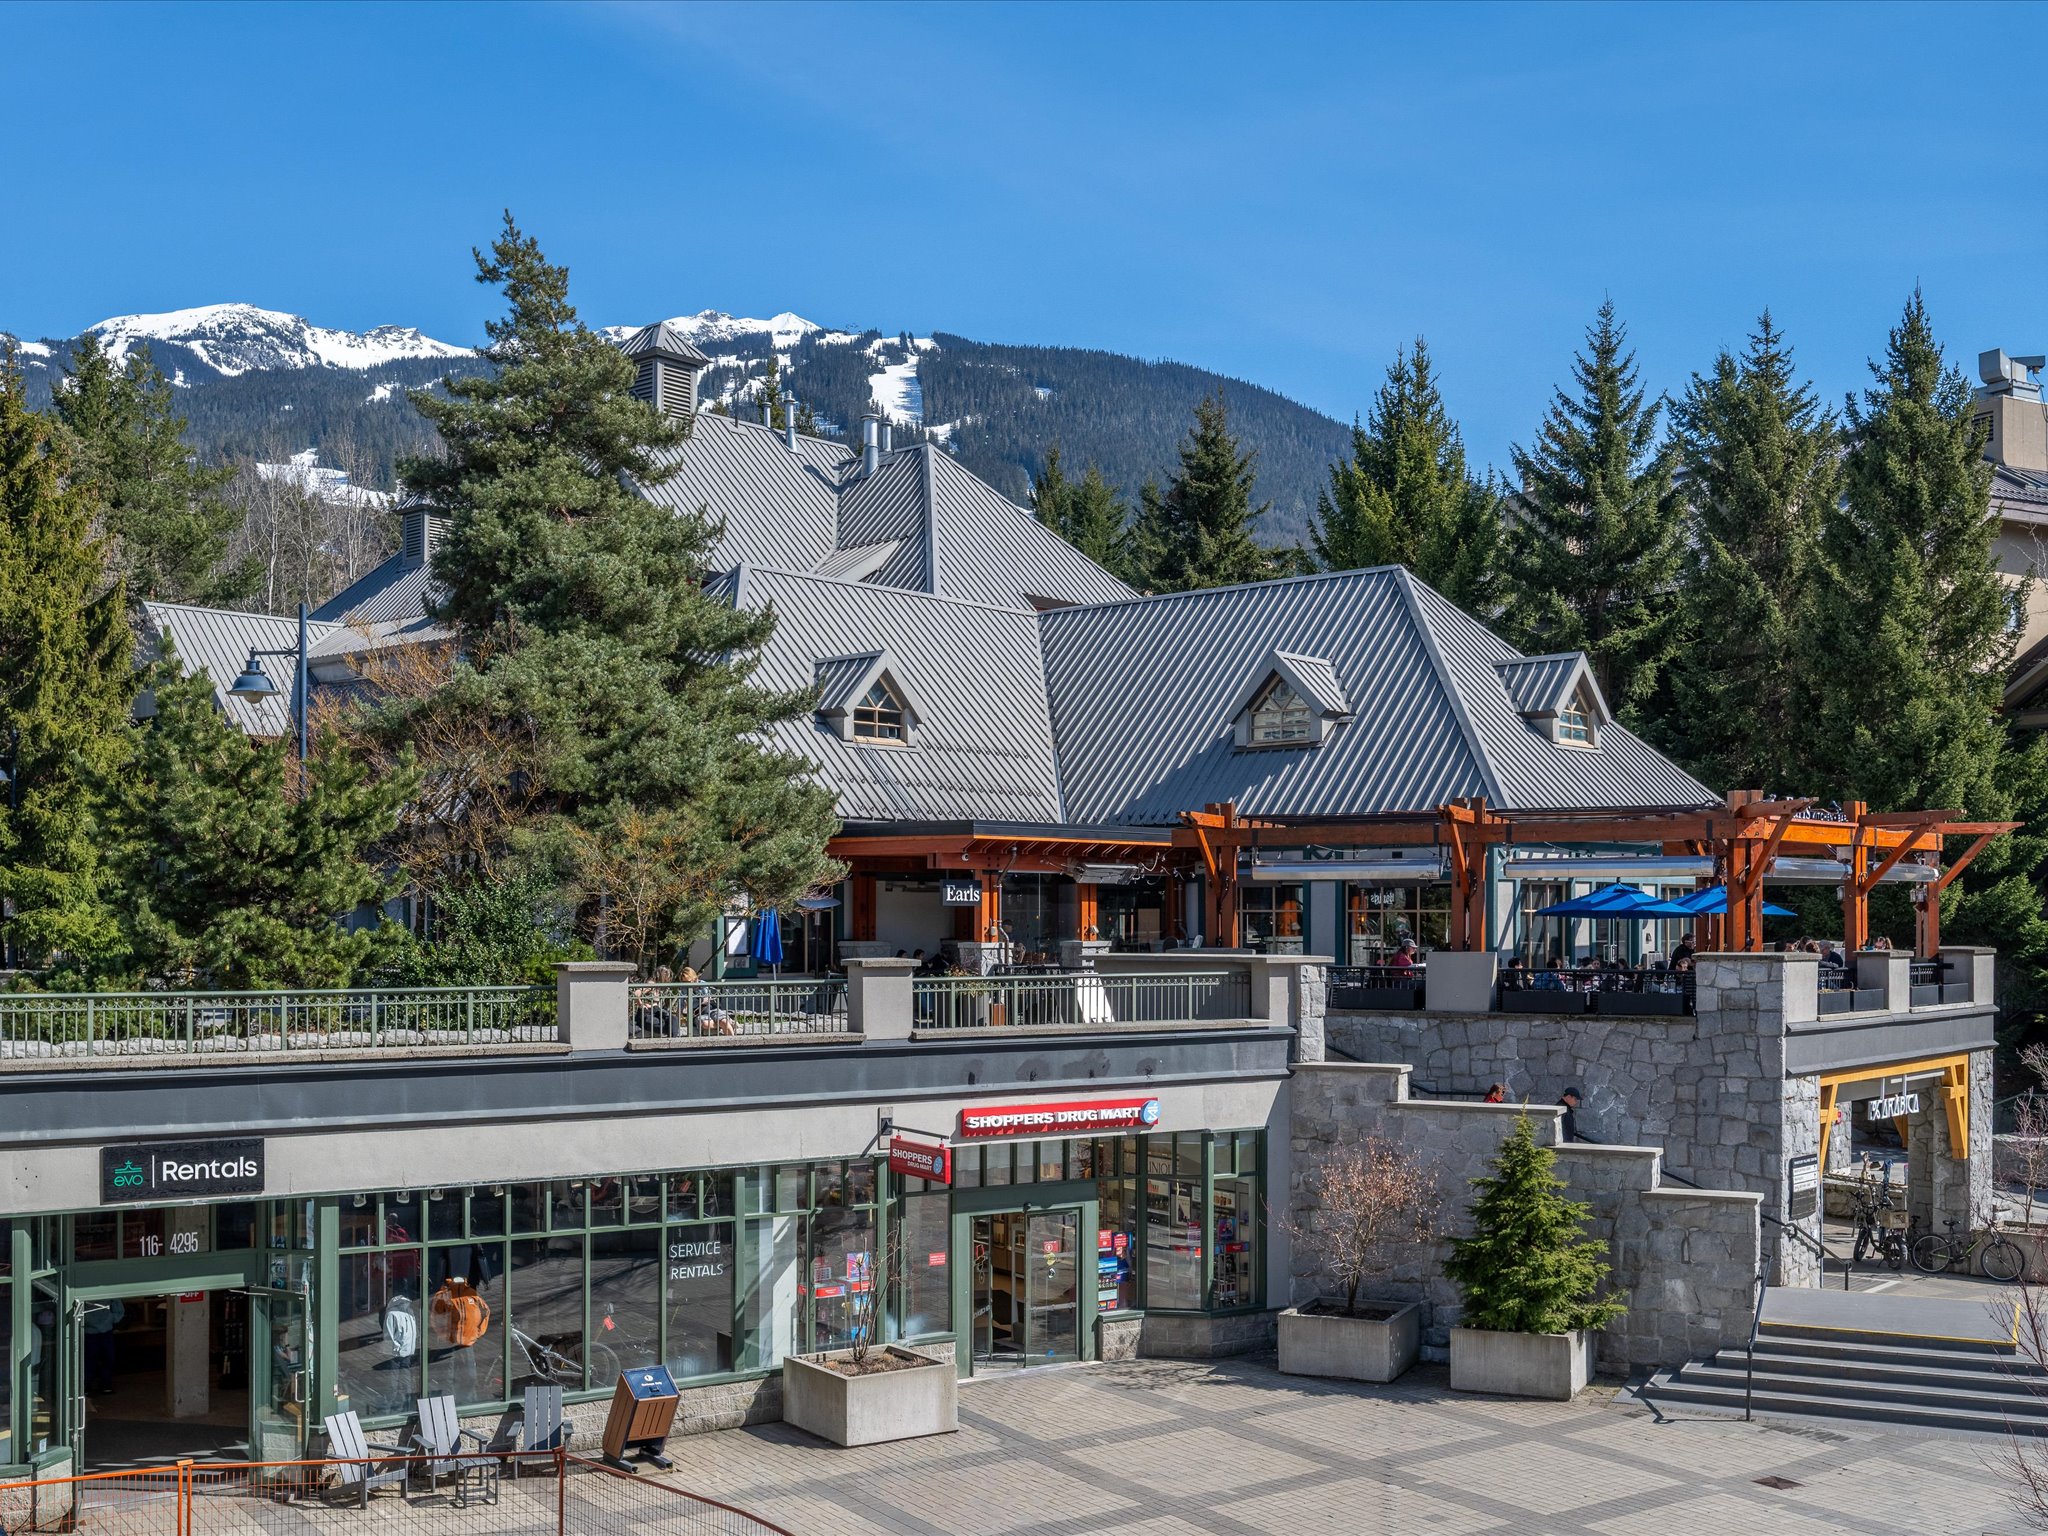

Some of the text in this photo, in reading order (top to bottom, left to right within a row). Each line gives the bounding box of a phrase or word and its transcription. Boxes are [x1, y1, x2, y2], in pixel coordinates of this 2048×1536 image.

[946, 884, 980, 902] Earls
[965, 1106, 1141, 1129] SHOPPERS DRUG MART
[892, 1148, 933, 1165] SHOPPERS
[113, 1156, 258, 1187] evo Rentals
[907, 1160, 933, 1171] DRUG MART
[139, 1231, 199, 1257] 116- 4295
[669, 1241, 721, 1258] SERVICE
[671, 1263, 724, 1280] RENTALS
